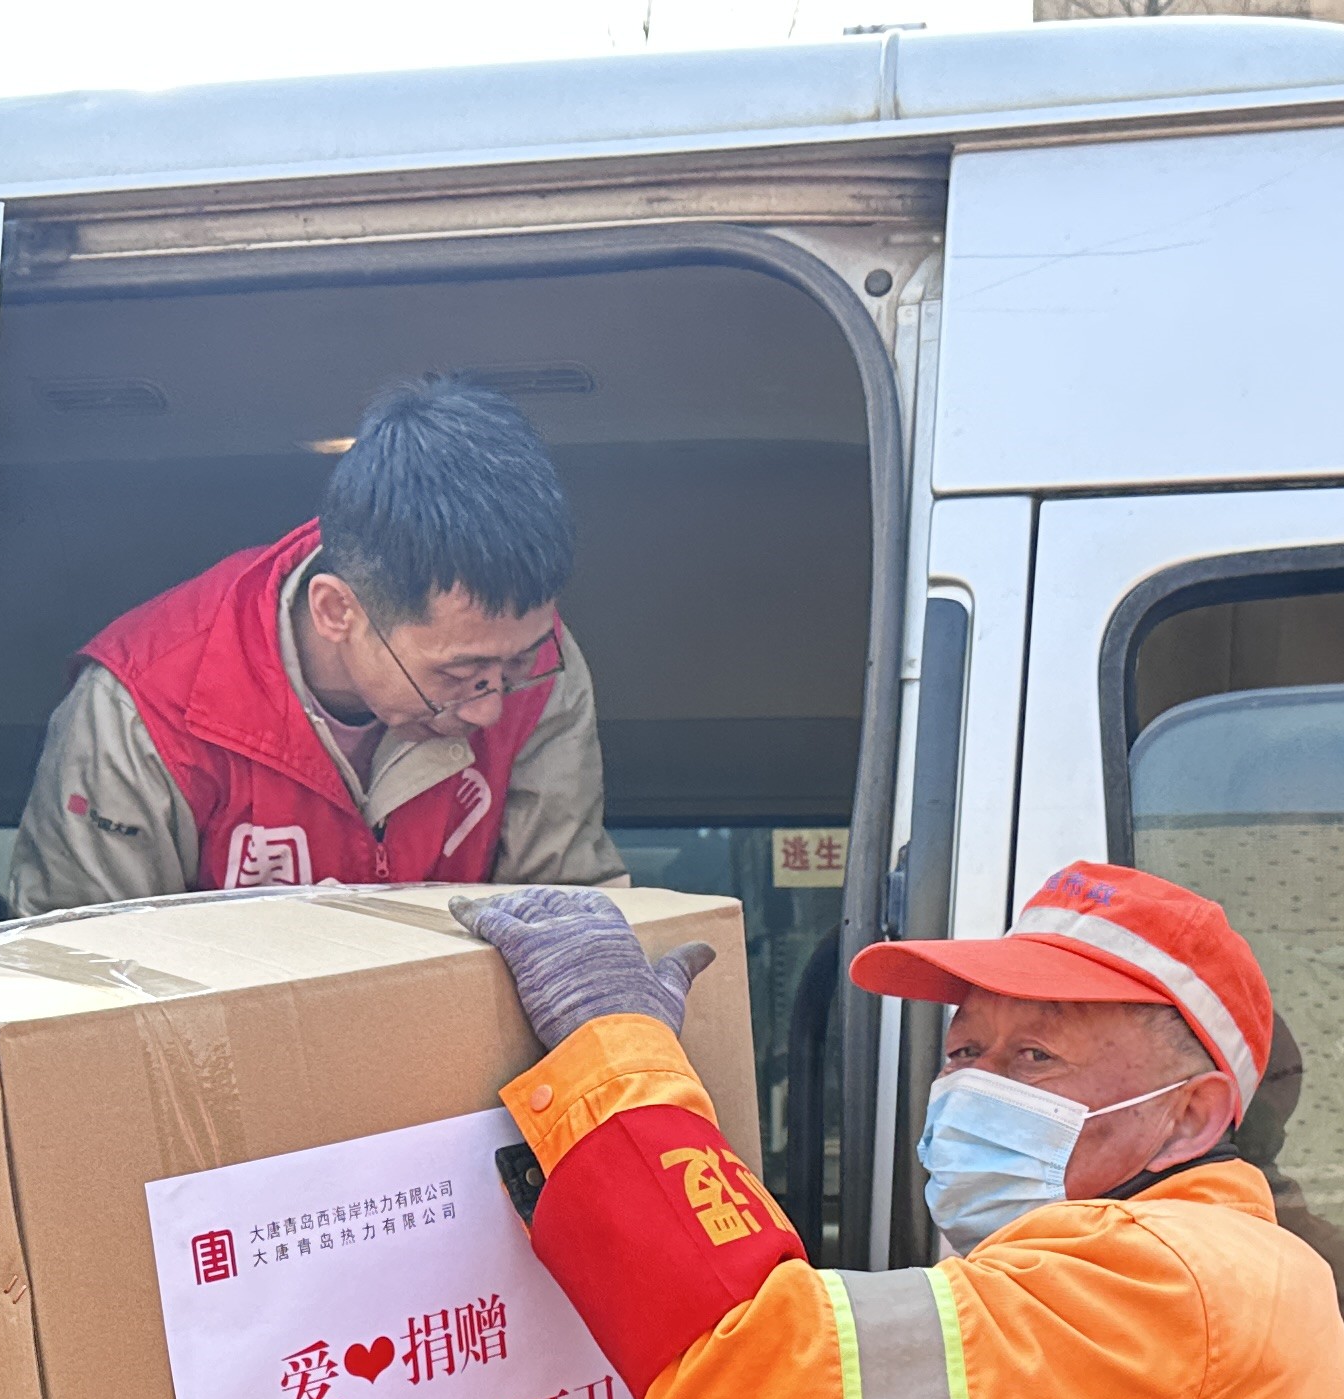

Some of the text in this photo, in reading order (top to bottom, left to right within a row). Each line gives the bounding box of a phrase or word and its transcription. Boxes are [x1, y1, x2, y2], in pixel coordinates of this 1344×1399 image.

[781, 835, 844, 872] 逃生
[249, 1179, 454, 1245] 大唐青岛西海岸热力有限公司
[252, 1202, 457, 1268] 大唐青岛热力有限公司
